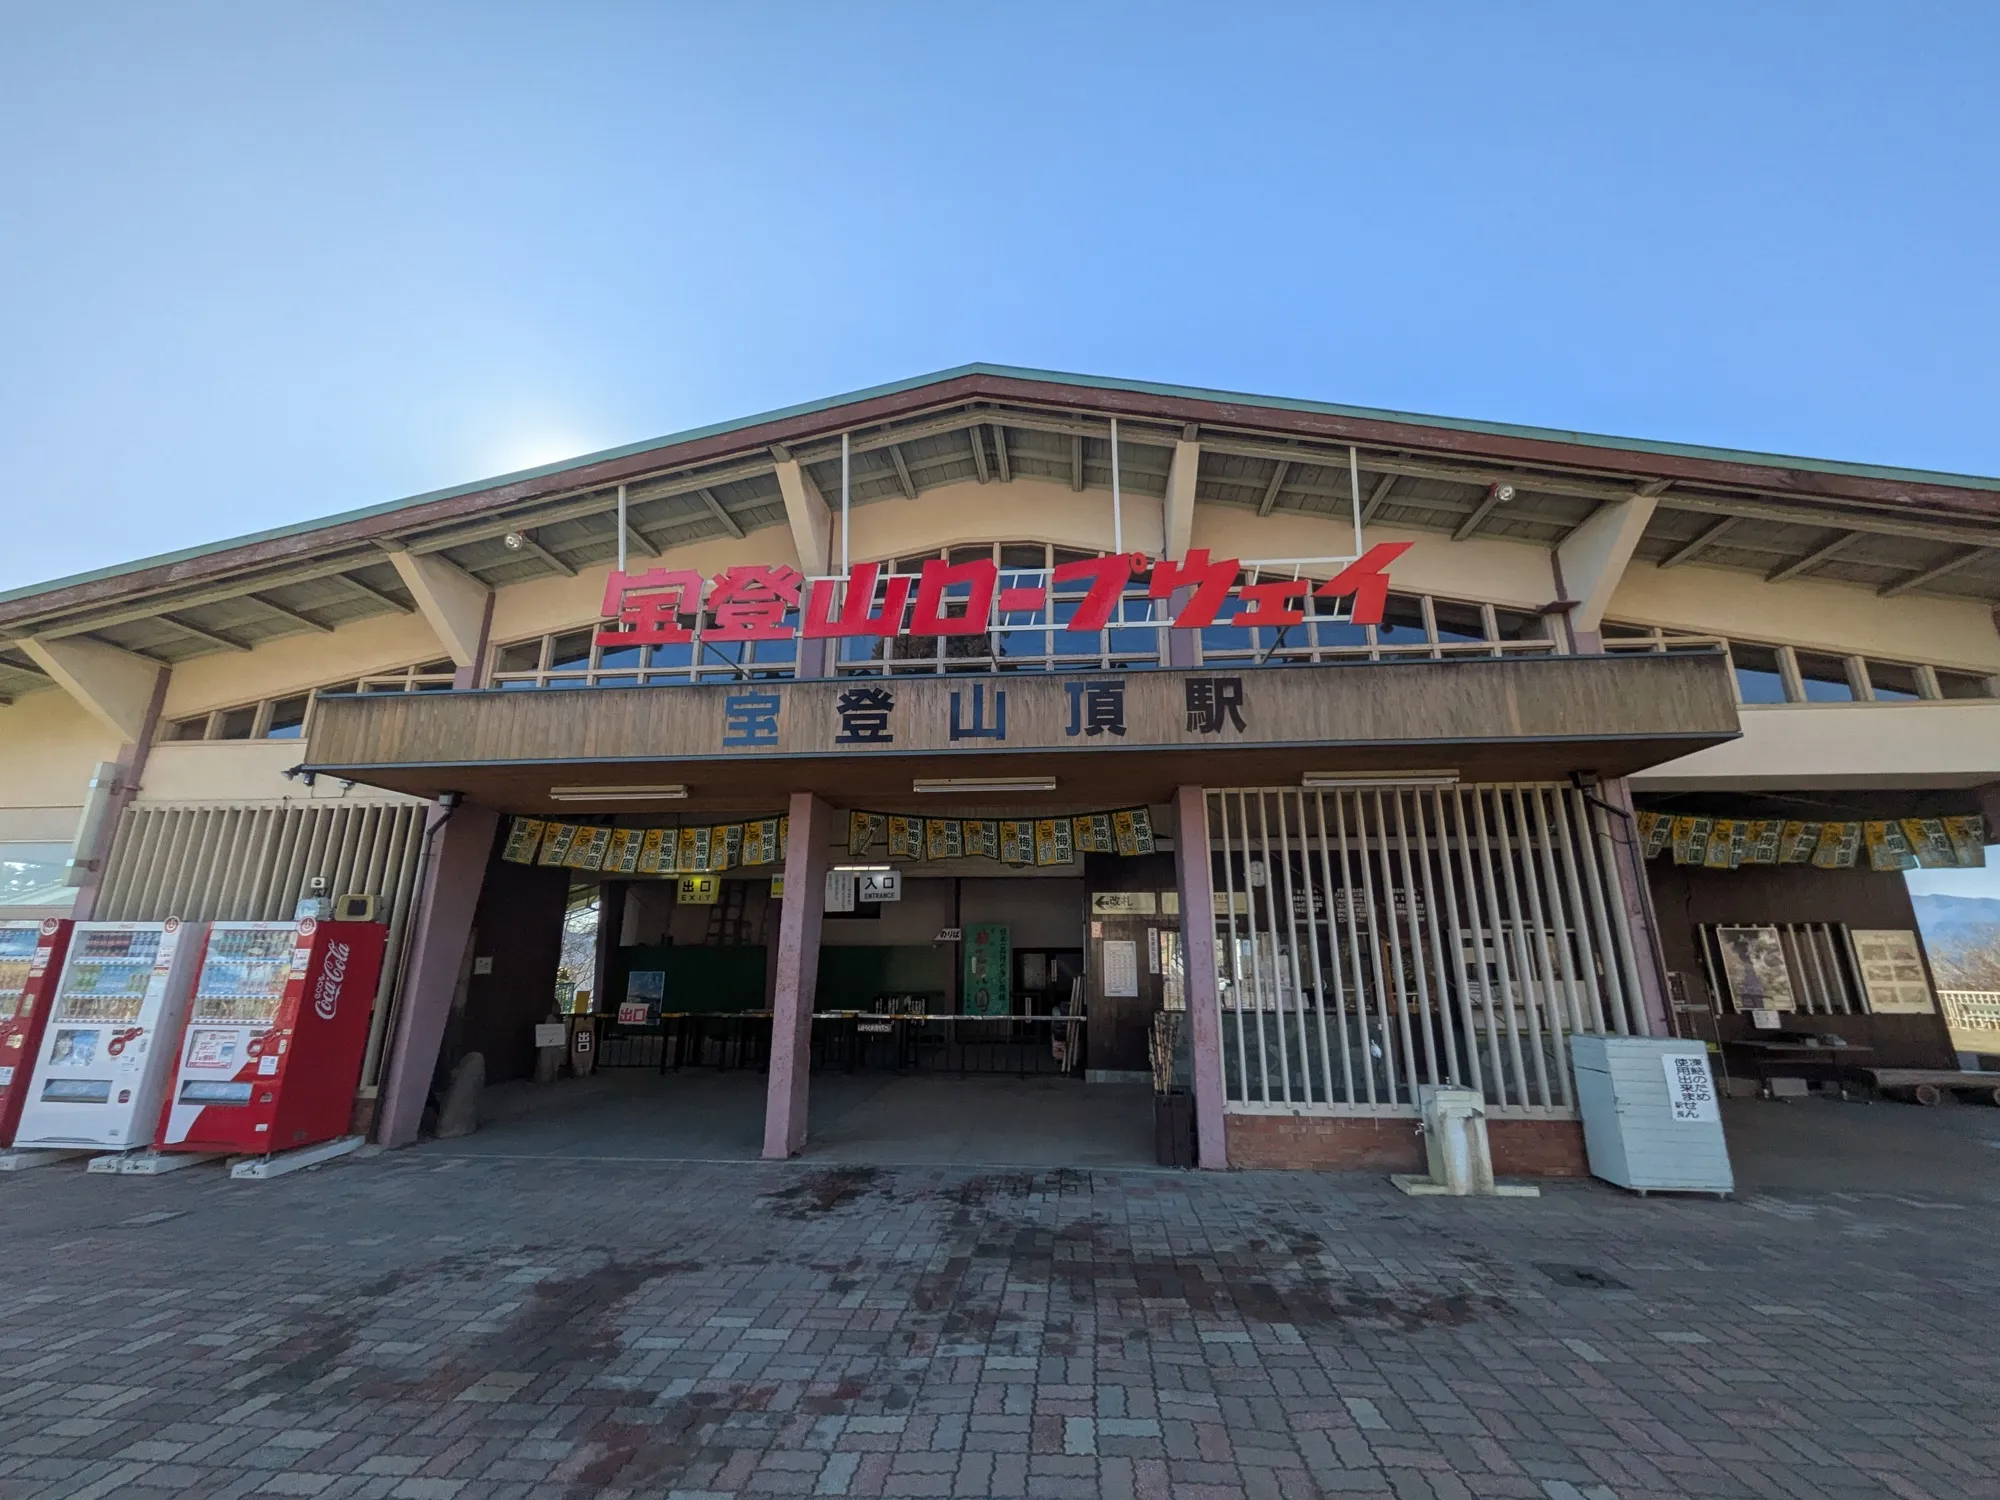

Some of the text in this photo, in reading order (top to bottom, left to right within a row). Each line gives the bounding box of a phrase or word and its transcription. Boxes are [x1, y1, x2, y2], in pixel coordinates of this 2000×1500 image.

[596, 541, 1415, 647] 宝登山ロープウェイ
[722, 677, 1247, 746] 宝登山頂駅
[683, 880, 711, 893] 出口
[864, 892, 895, 900] ENTRANCE
[865, 877, 894, 890] 入口
[315, 938, 350, 1020] Coca-Cola
[619, 1008, 646, 1022] 出口
[578, 1031, 590, 1053] 出口
[1675, 1058, 1699, 1118] 使用出来ません
[1688, 1058, 1711, 1101] 凍結のため
